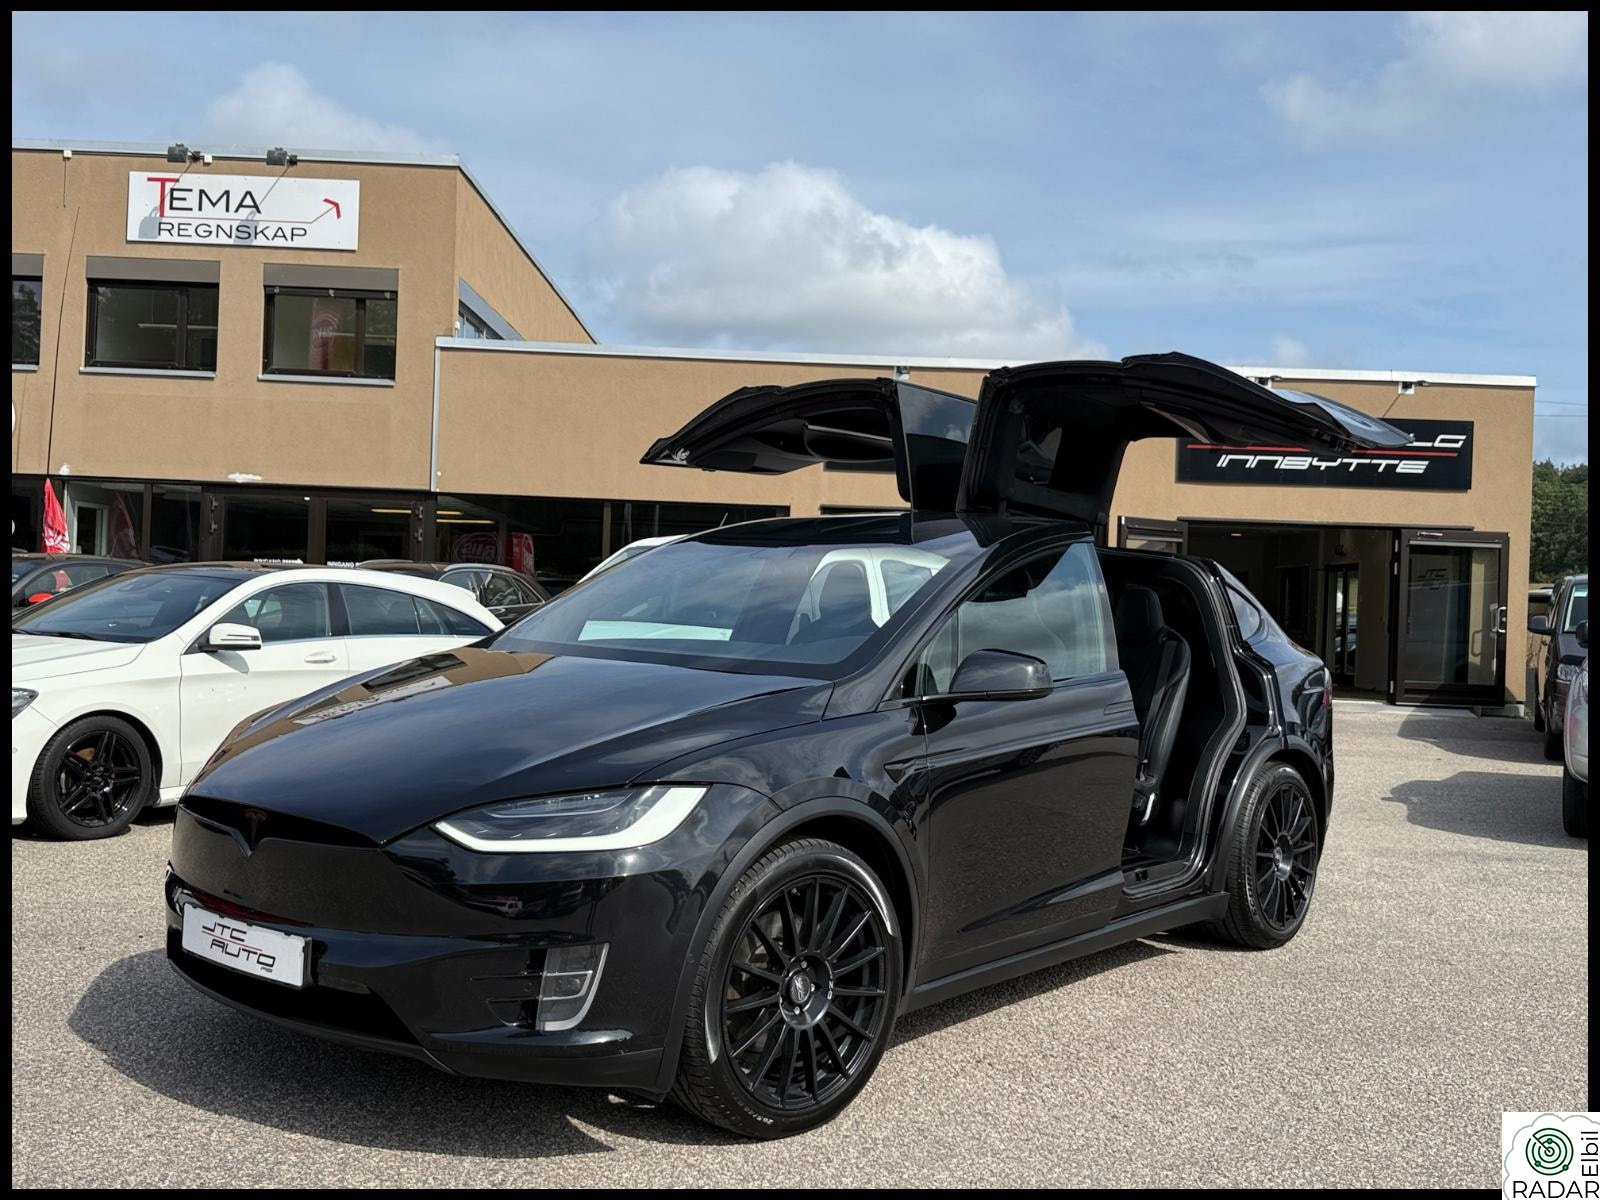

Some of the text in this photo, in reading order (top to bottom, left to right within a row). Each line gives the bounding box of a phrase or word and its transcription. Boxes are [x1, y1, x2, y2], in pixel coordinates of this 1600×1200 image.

[147, 177, 262, 218] TEMA
[157, 222, 308, 242] REGNSKAP
[1216, 453, 1430, 474] INNBYTTE
[201, 921, 247, 943] JTC
[209, 938, 276, 968] AUTO
